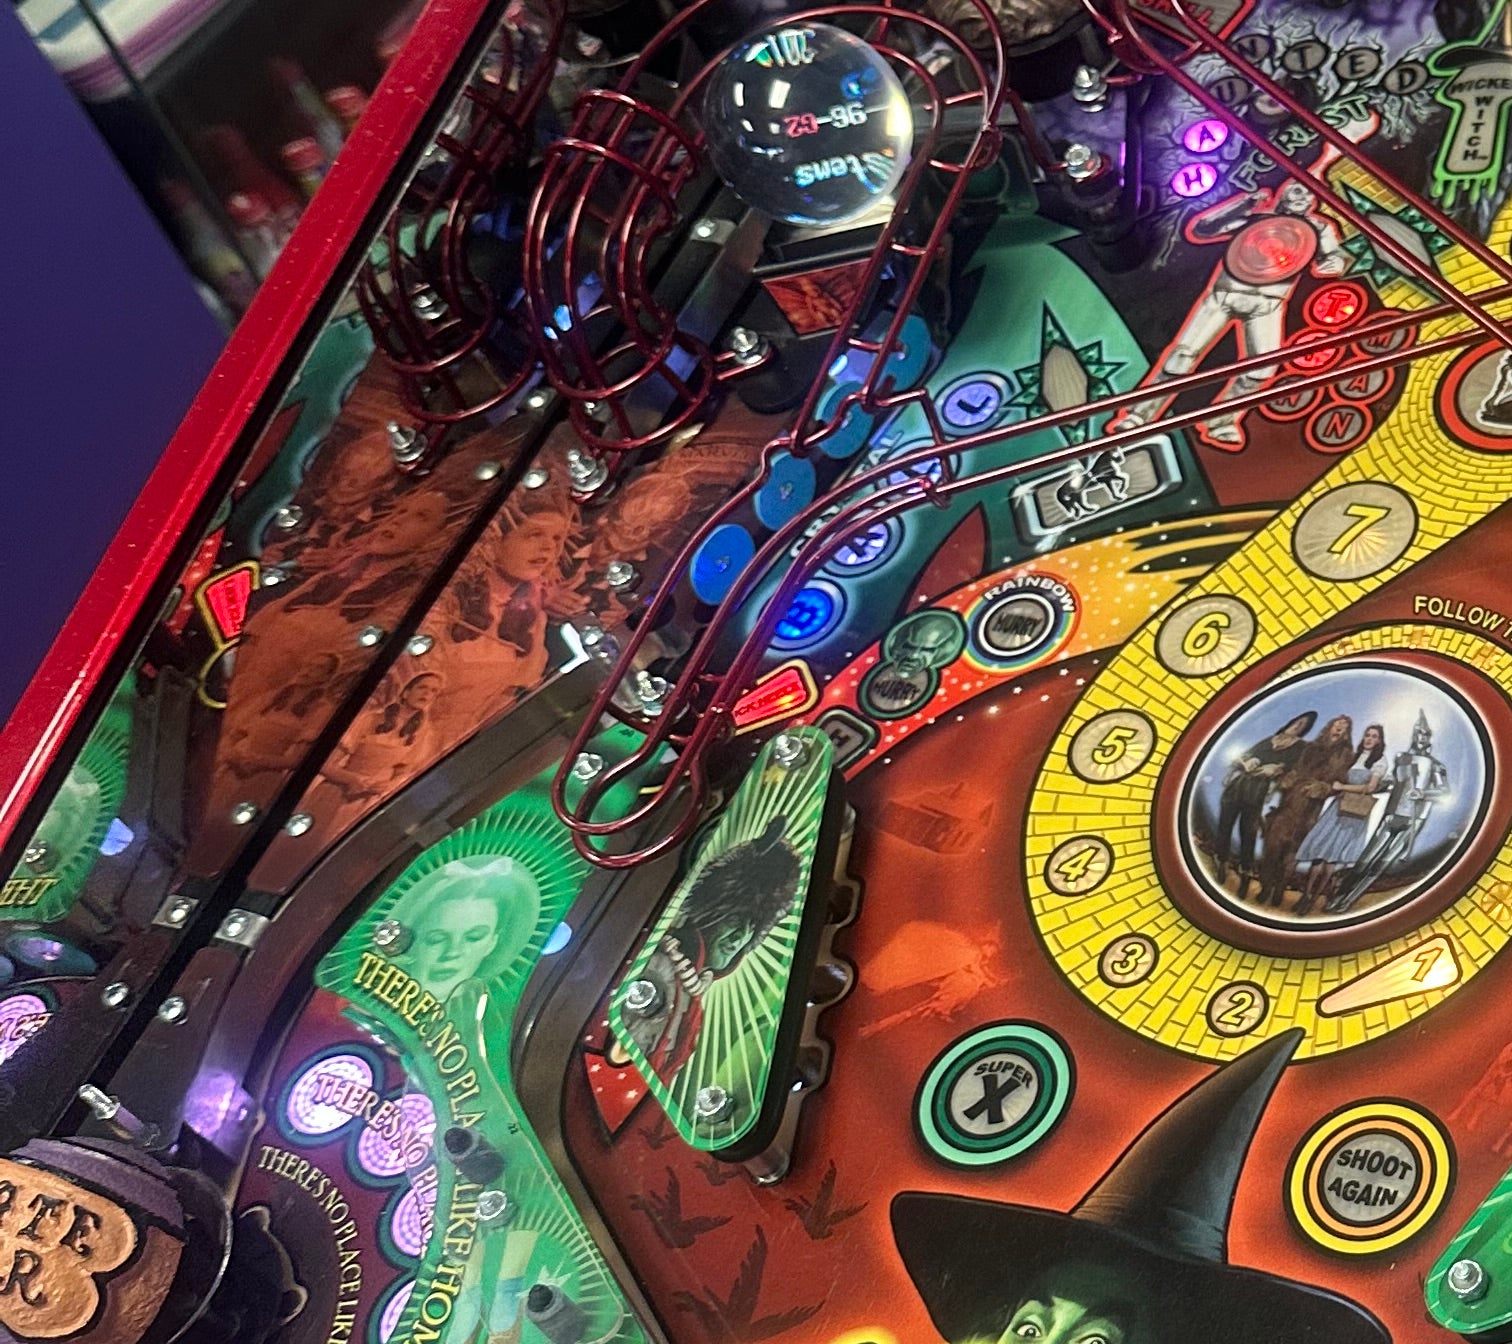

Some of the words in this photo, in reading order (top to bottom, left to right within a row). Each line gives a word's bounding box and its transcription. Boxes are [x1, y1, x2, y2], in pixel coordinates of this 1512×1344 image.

[1328, 502, 1392, 555] 7
[983, 576, 1076, 613] RAINBOW
[1413, 594, 1504, 632] FOLLOW
[993, 610, 1044, 638] HURRY
[1182, 610, 1231, 659] 6
[872, 677, 923, 703] HURRY
[1091, 724, 1137, 766] 5
[1054, 844, 1101, 883] 4
[1110, 941, 1147, 976] 3
[1410, 946, 1445, 984] 1
[352, 951, 446, 1038] THERE'S
[1216, 988, 1257, 1028] 2
[425, 1021, 470, 1075] NO
[973, 1060, 1034, 1089] SUPER
[962, 1073, 1023, 1125] X
[256, 1144, 331, 1199] THERE'S
[1336, 1148, 1414, 1181] SHOOT
[319, 1188, 350, 1224] NO
[1326, 1176, 1399, 1209] AGAIN
[442, 1182, 485, 1257] LIKE
[333, 1218, 363, 1297] PLACE
